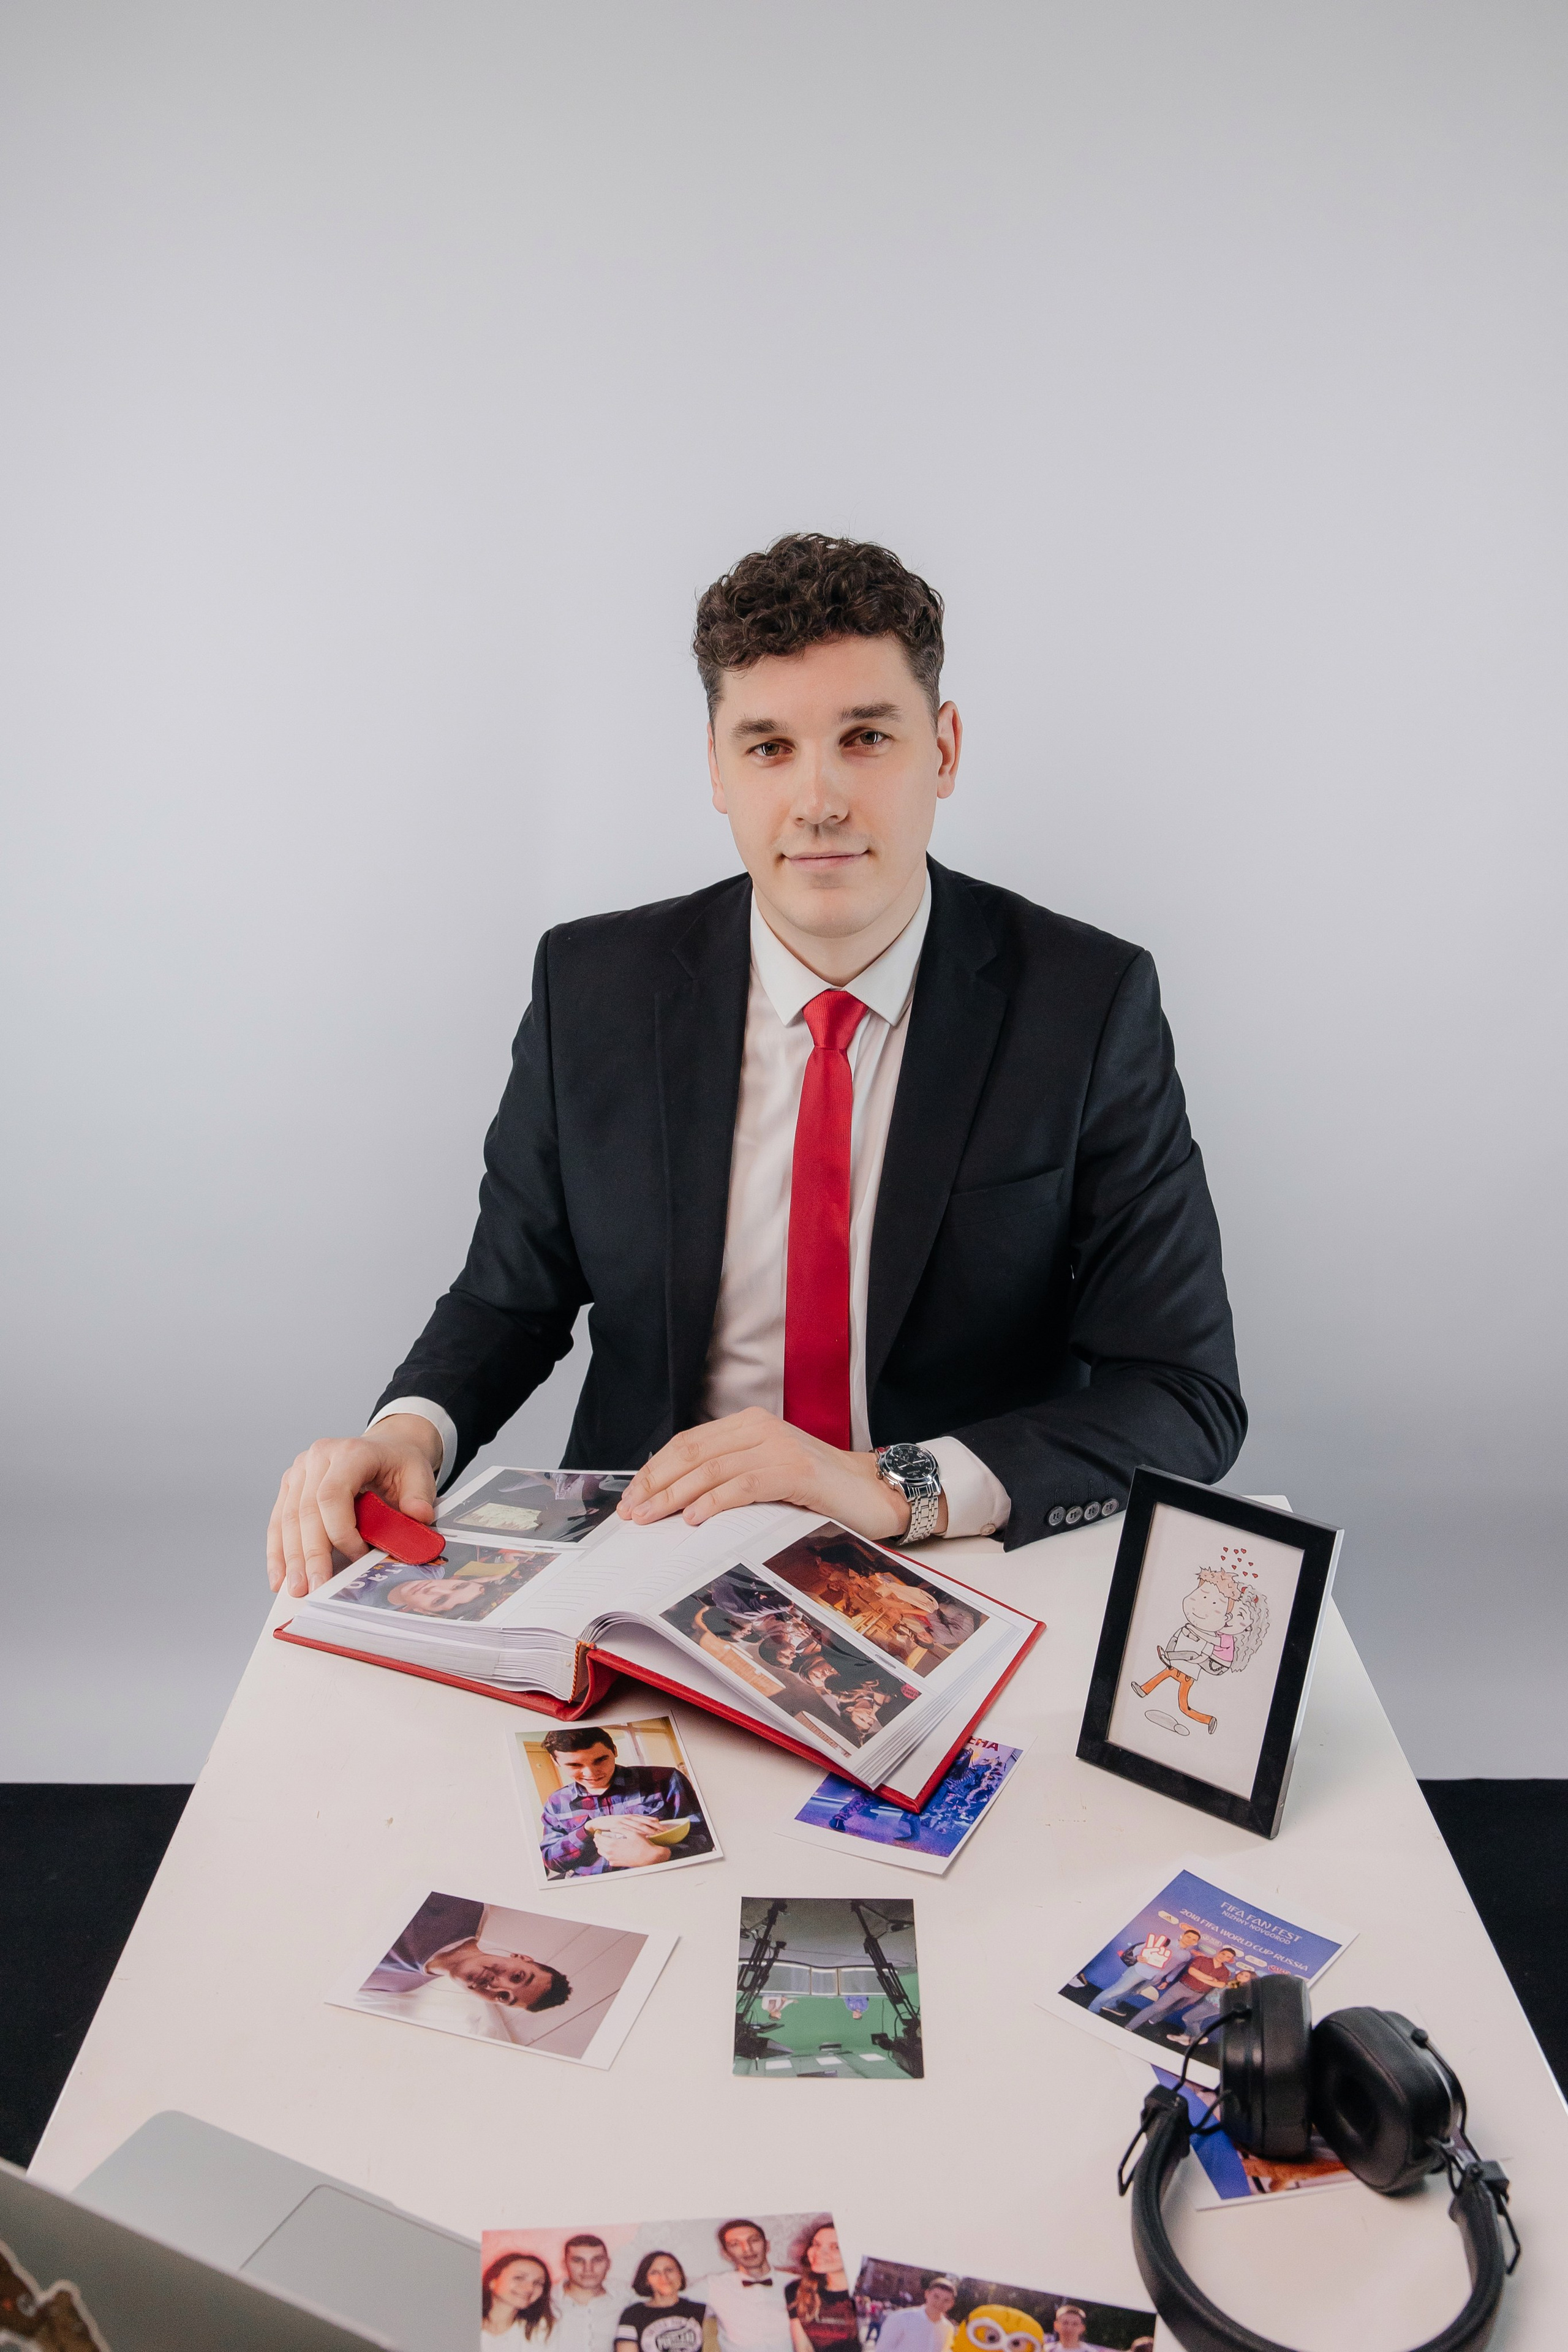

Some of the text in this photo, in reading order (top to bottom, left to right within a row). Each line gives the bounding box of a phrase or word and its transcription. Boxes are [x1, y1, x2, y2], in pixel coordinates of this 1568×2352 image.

[1180, 1908, 1200, 1922] 2018
[1200, 1919, 1219, 1932] FIFA
[1219, 1929, 1253, 1948] WORLD
[1253, 1945, 1274, 1955] CUP
[1273, 1953, 1308, 1972] RUSSIA
[1221, 1901, 1303, 1942] FIFA FAN FEST
[1222, 1910, 1291, 1945] NIZHNY NOVGOROD
